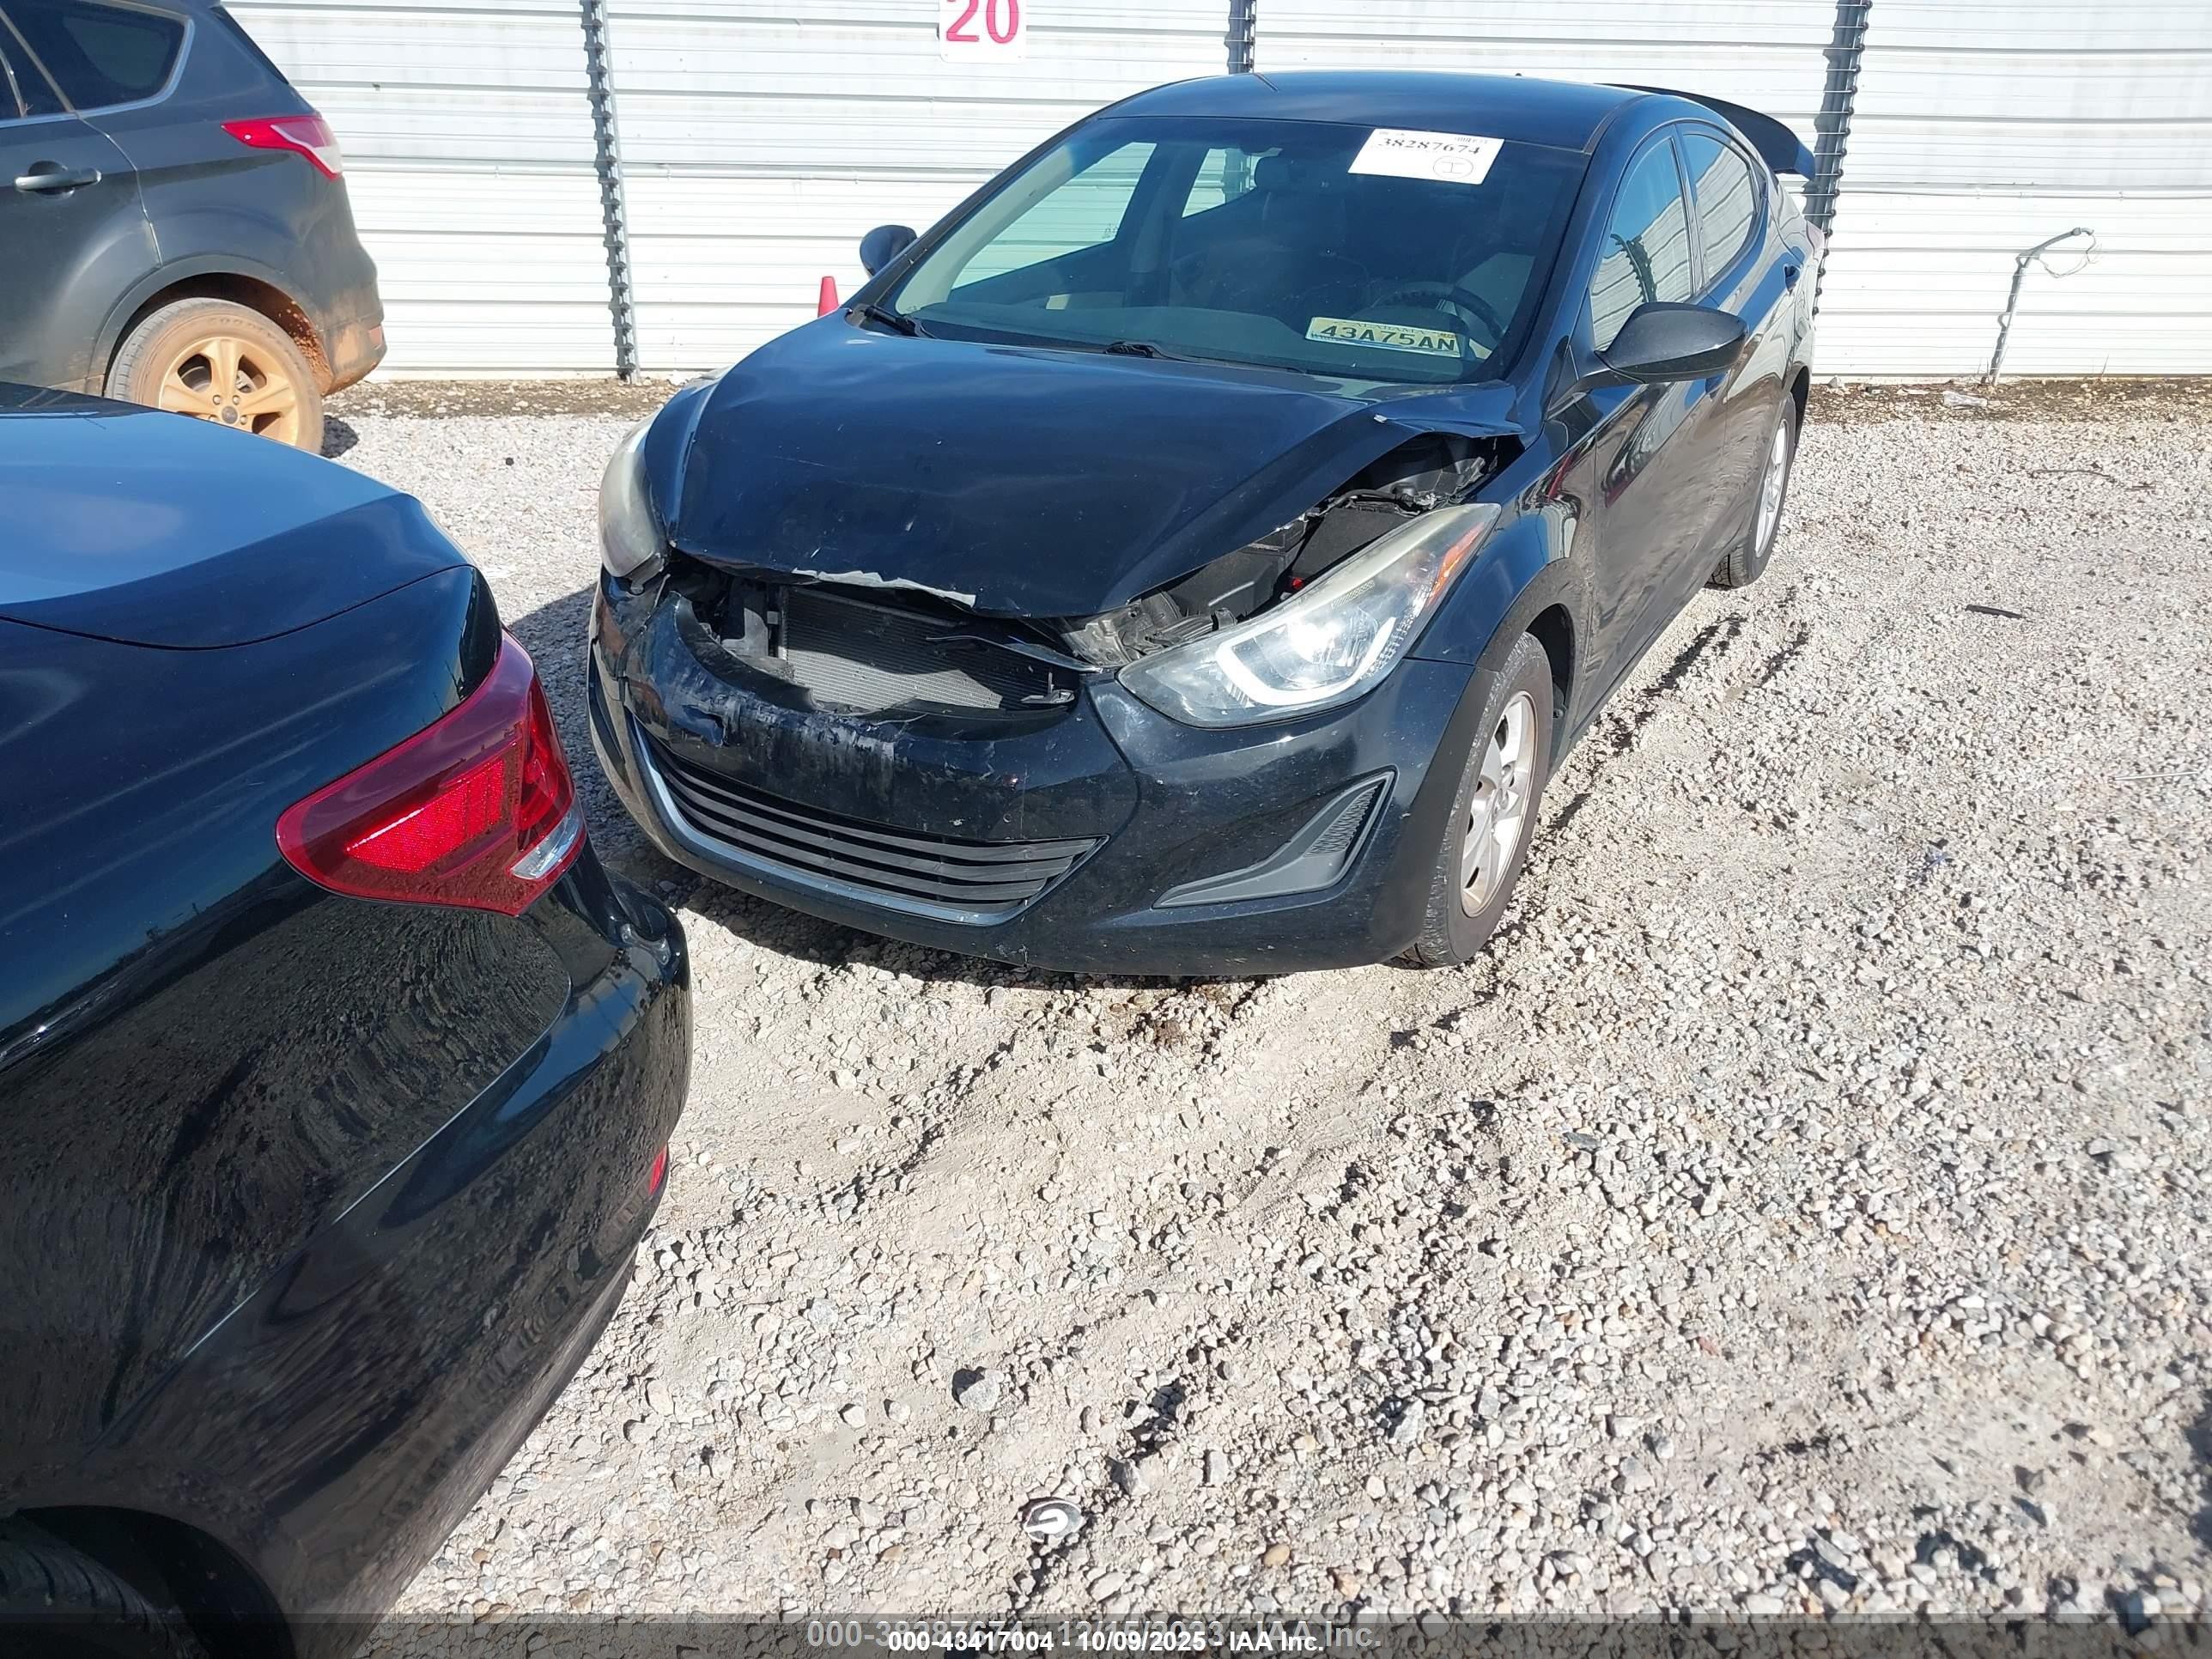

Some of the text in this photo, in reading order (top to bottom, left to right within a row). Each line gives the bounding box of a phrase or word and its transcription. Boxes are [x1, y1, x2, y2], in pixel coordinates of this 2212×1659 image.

[946, 0, 1019, 44] 20
[1377, 137, 1480, 155] 38287674
[1321, 325, 1455, 351] 43A75AN
